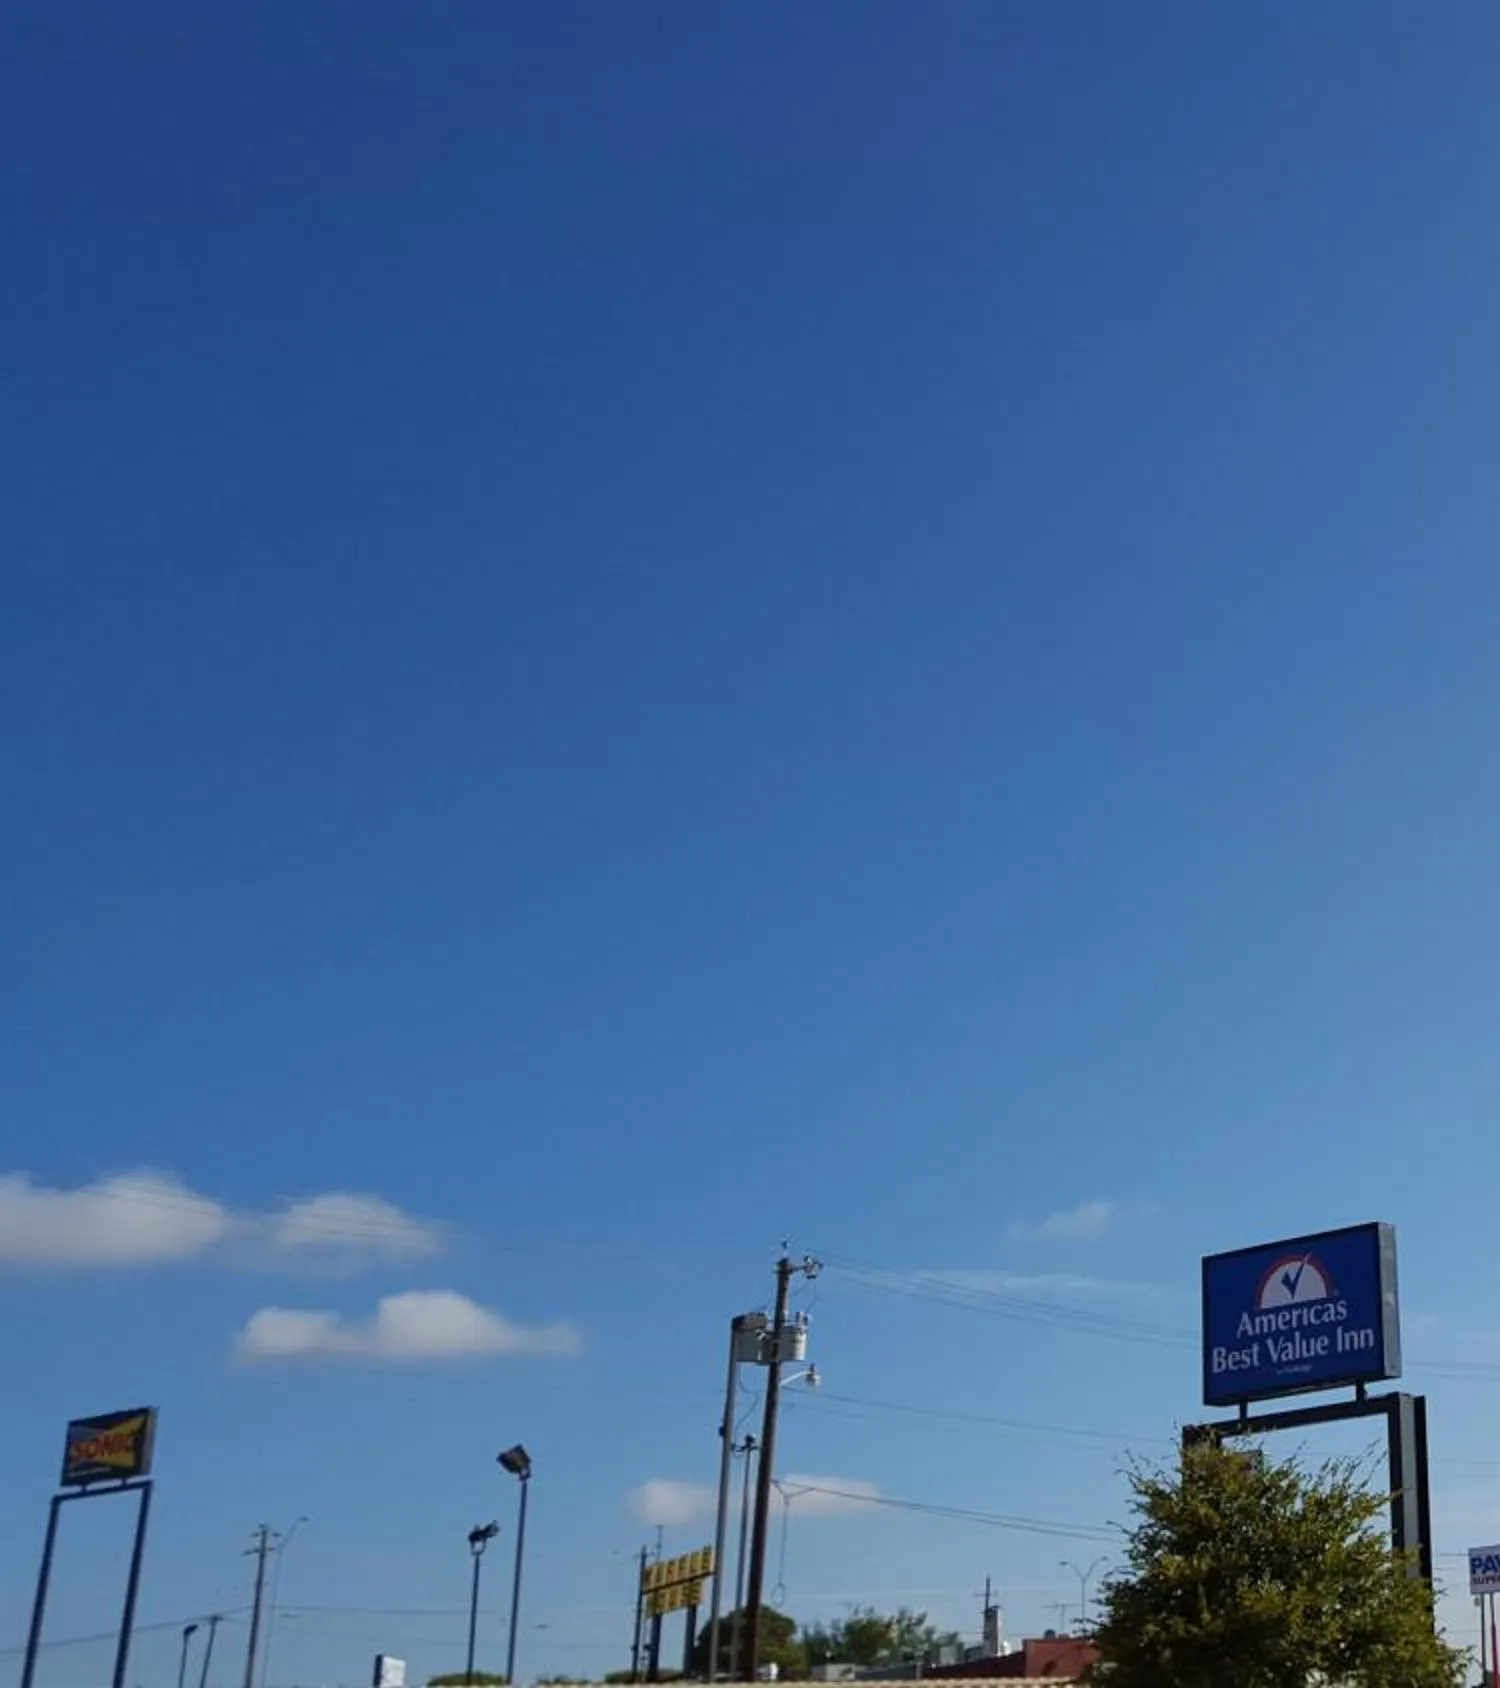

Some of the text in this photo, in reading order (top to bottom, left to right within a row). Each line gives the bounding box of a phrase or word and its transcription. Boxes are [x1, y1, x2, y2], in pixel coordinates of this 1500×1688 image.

[1236, 1299, 1348, 1339] Americas
[1212, 1325, 1374, 1373] Best Value Inn
